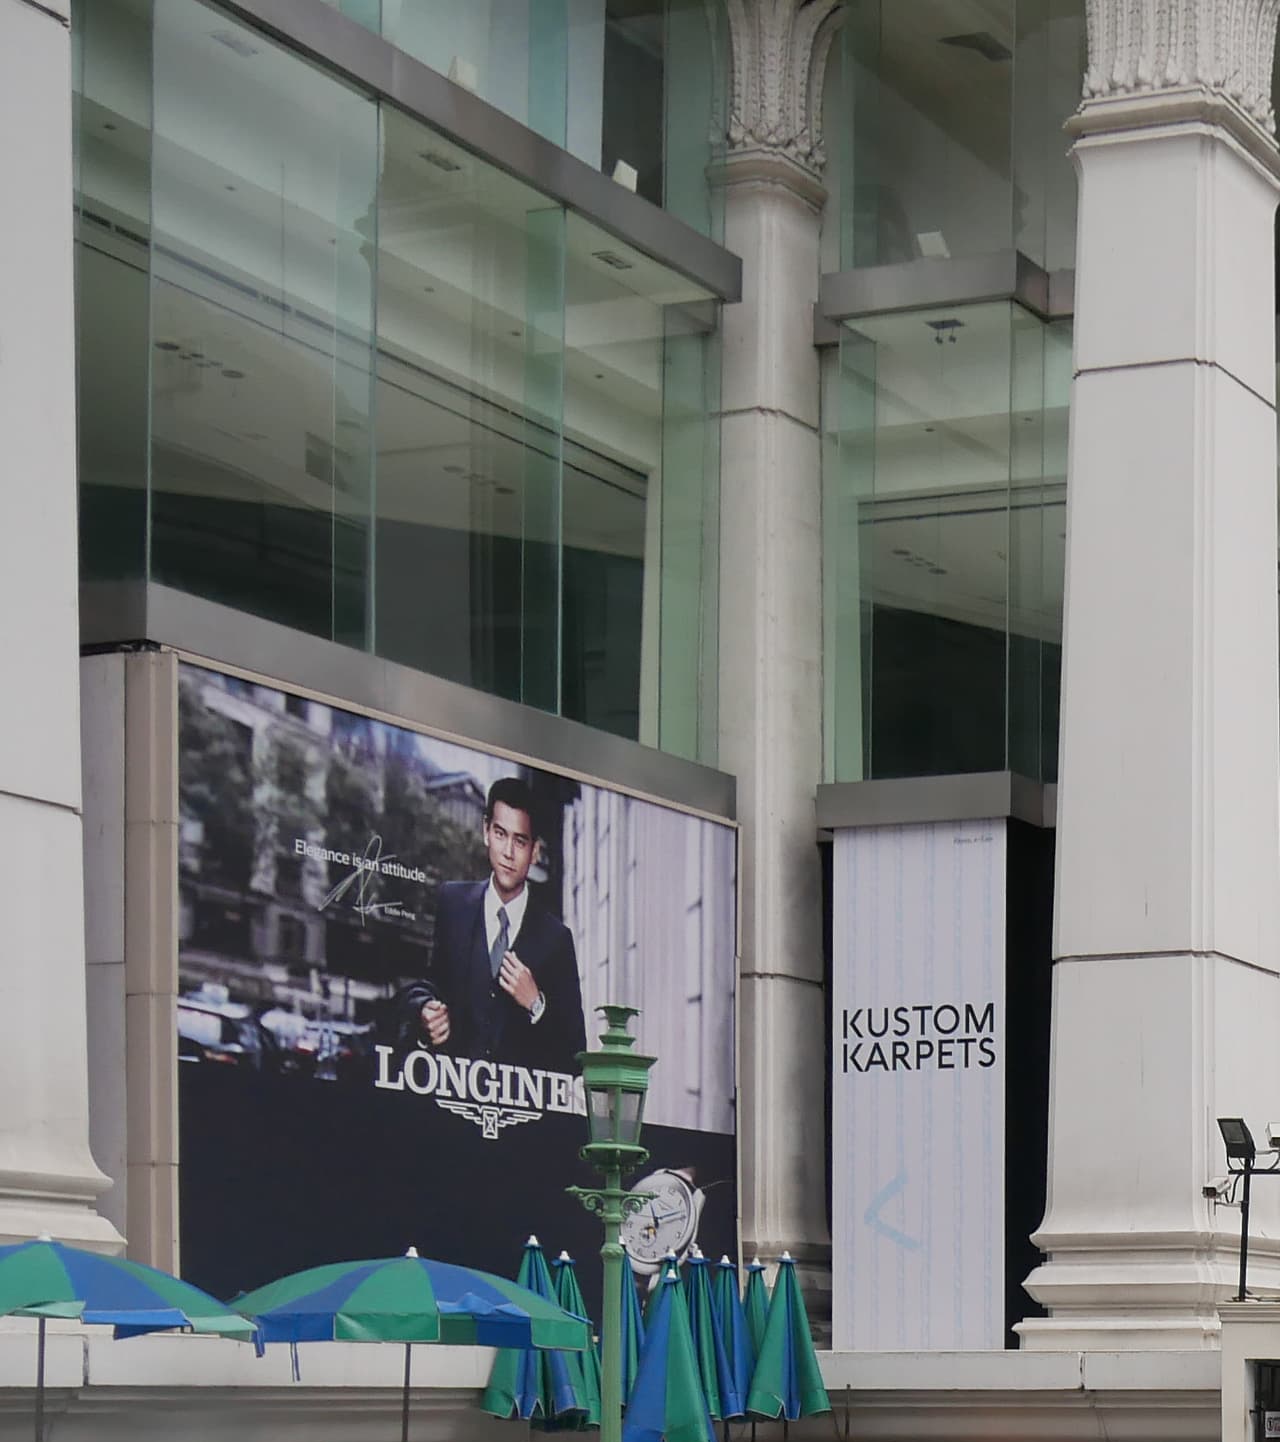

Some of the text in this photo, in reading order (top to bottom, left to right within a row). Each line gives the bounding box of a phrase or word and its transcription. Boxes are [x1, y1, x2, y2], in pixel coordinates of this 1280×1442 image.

[295, 838, 426, 882] Elegance is an attitude
[843, 1003, 994, 1039] KUSTOM
[843, 1037, 996, 1073] KARPETS
